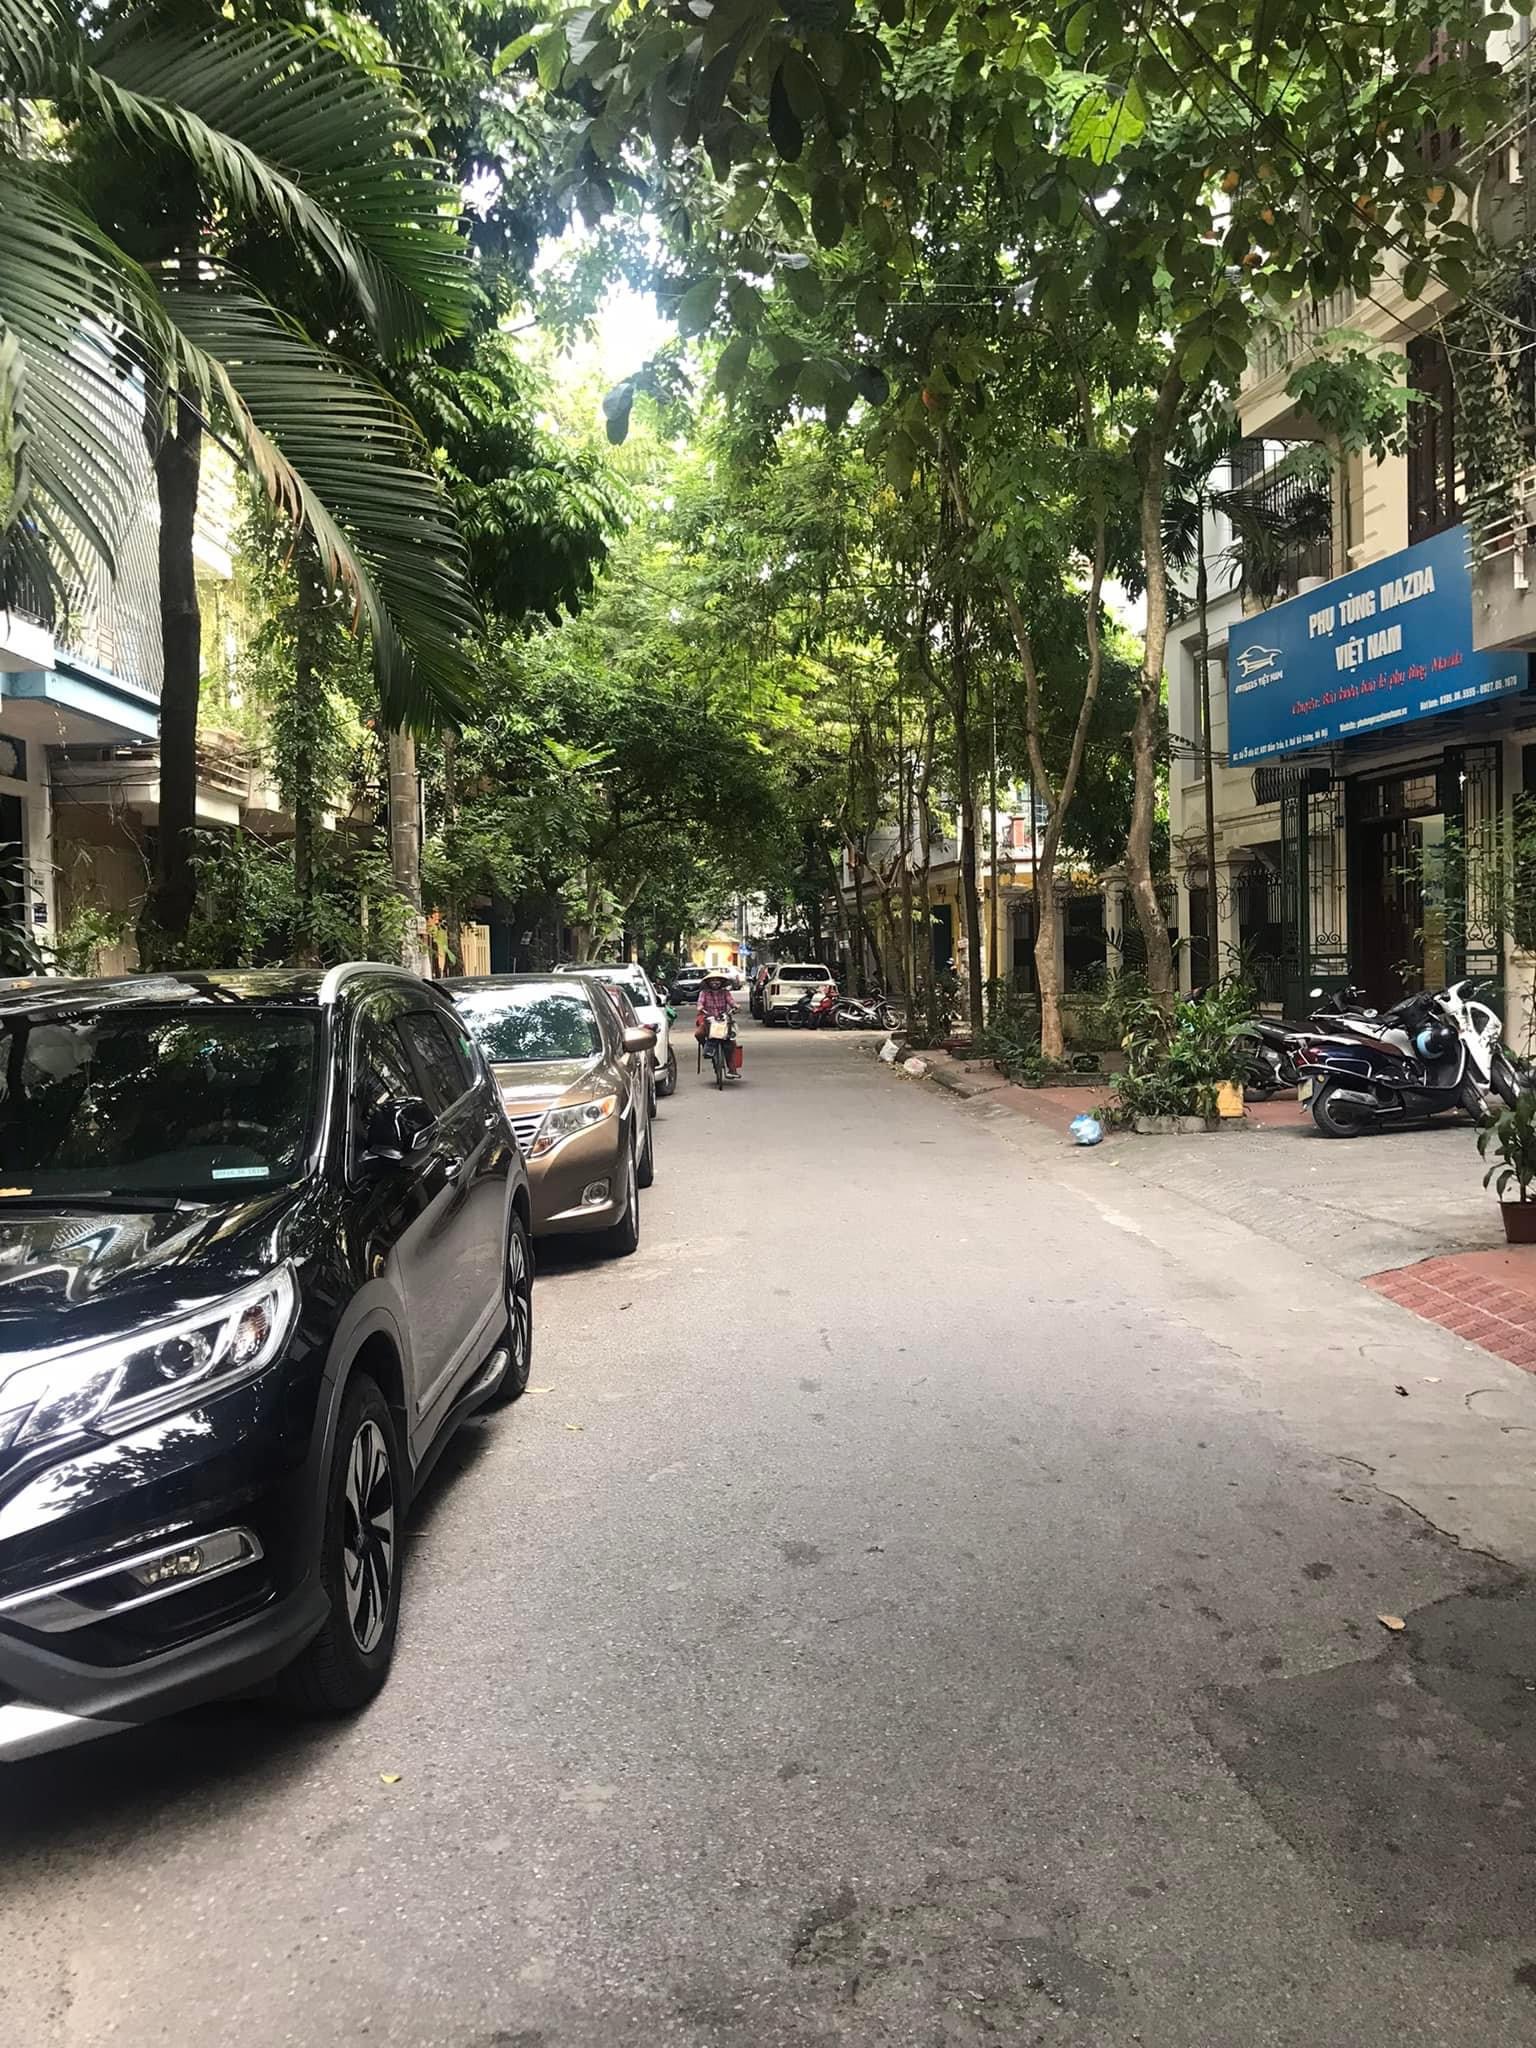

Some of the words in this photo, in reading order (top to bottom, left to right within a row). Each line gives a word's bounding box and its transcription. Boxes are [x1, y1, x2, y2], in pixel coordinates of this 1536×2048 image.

[1309, 606, 1335, 639] PHỤ
[1339, 590, 1376, 626] TÙNG
[1379, 566, 1435, 611] MAZDA
[1335, 636, 1364, 672] VIỆT
[1367, 624, 1402, 661] NAM
